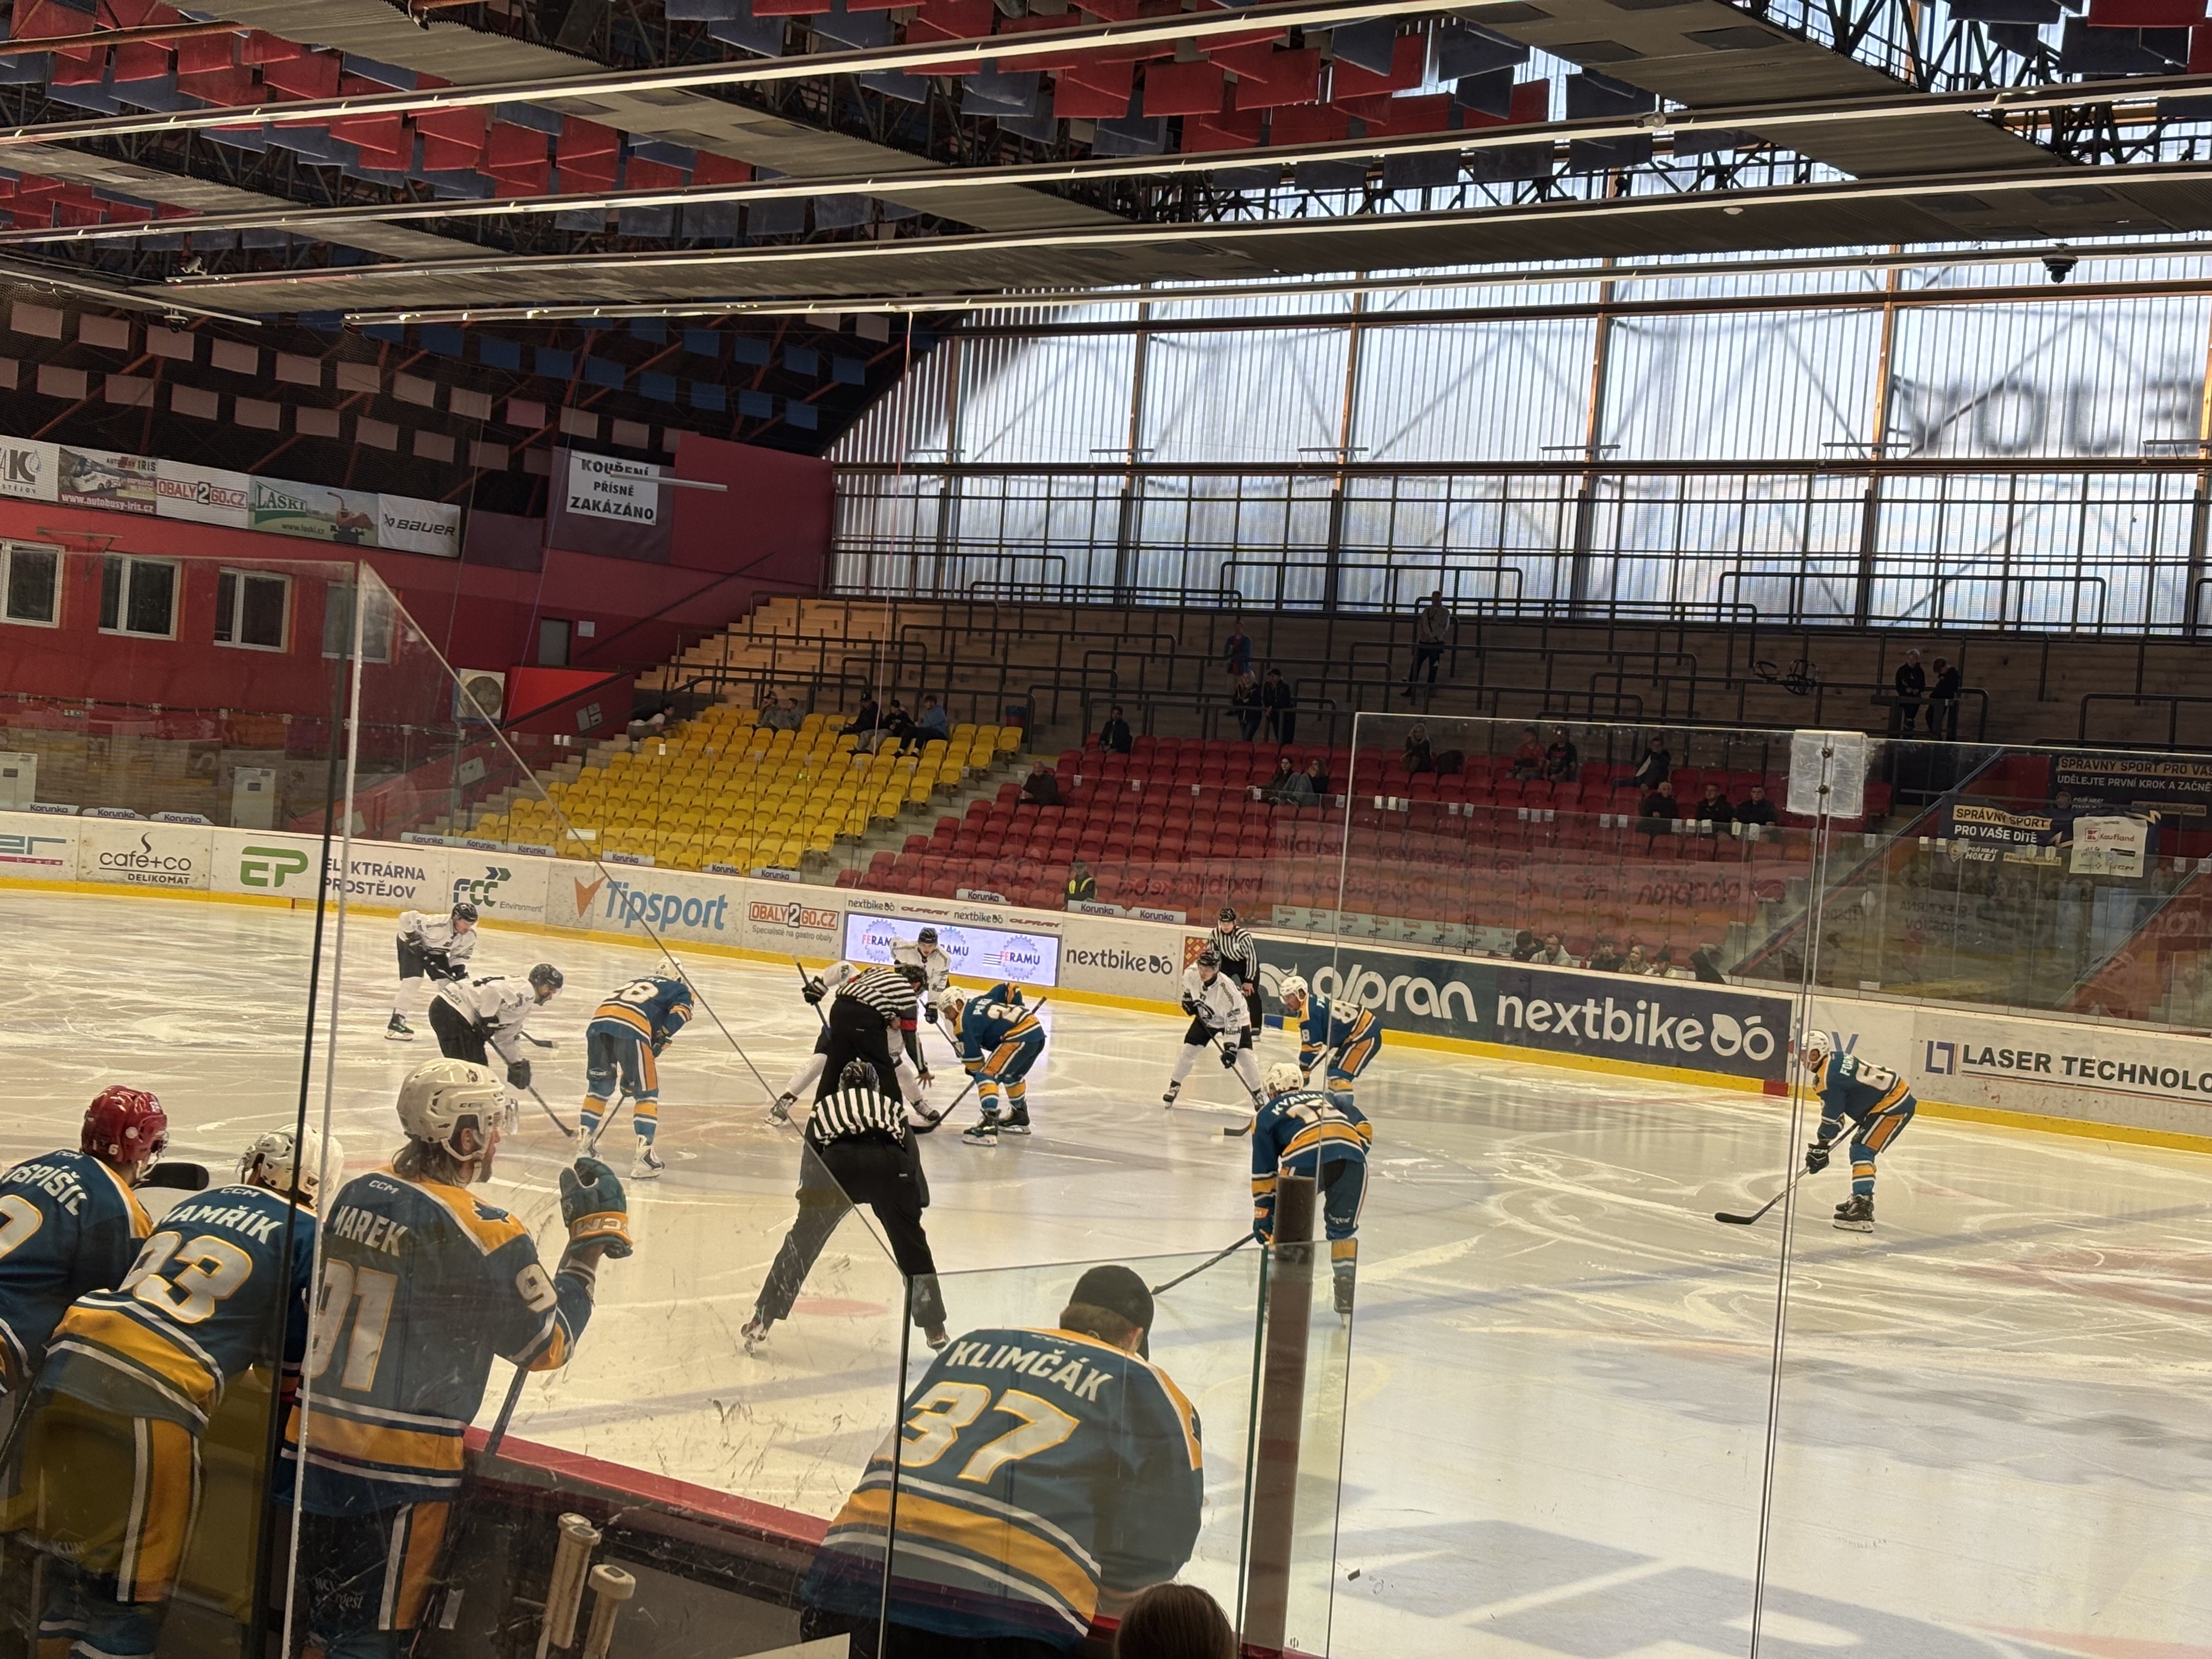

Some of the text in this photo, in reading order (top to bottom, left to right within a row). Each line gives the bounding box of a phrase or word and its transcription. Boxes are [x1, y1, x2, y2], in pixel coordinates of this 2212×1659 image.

[138, 459, 156, 472] IRIS
[158, 481, 246, 507] OBALY2GO.CZ
[594, 480, 634, 496] PŘÍSNĚ
[61, 493, 154, 513] www.autobusy-iris.cz
[570, 496, 654, 520] ZAKÁZÁNO
[281, 523, 325, 535] www.laski.cz
[2121, 761, 2159, 773] SPORT
[2163, 763, 2187, 774] PRO
[2057, 774, 2105, 786] UDĚLEJTE
[2108, 777, 2137, 787] PRVNÍ
[2139, 779, 2165, 789] KROK
[2178, 781, 2212, 792] ZAČNĚ
[30, 803, 68, 813] Korunka
[98, 809, 136, 819] Korunka
[165, 814, 201, 823] Korunka
[1956, 808, 2048, 828] SPRÁVNÝ SPORT
[412, 834, 443, 844] Korunka
[1954, 825, 2037, 843] PRO VAŠE DÍTĚ
[2100, 834, 2135, 842] Kaufland
[466, 840, 496, 850] Korunka
[517, 845, 546, 855] Korunka
[612, 853, 639, 864] Korunka
[1965, 853, 1996, 861] HOKEJ
[240, 845, 309, 888] EP
[326, 857, 426, 881] ELKTRÁRNA
[127, 873, 190, 884] DELIKOMAT
[761, 869, 790, 880] Korunka
[968, 891, 999, 902] Korunka
[500, 901, 543, 913] Environment
[606, 880, 729, 932] Tipsport
[848, 899, 884, 911] nextbike
[953, 911, 991, 923] nextbike
[1081, 903, 1114, 916] Korunka
[751, 903, 837, 928] OBALY2GO.CZ
[1140, 909, 1174, 922] Korunka
[816, 933, 834, 943] obaly
[1000, 950, 1041, 966] FERAMU
[1066, 949, 1146, 973] nextbike
[1312, 963, 1478, 1023] olpran
[1497, 994, 1703, 1052] nextbike
[1962, 1044, 2052, 1074] LASER
[220, 1187, 261, 1198] CCM
[369, 1180, 399, 1194] CCM
[333, 1205, 409, 1257] MAREK
[115, 1231, 253, 1324] 23
[945, 1340, 1115, 1402] KLIMČÁK
[872, 1381, 1081, 1485] 37
